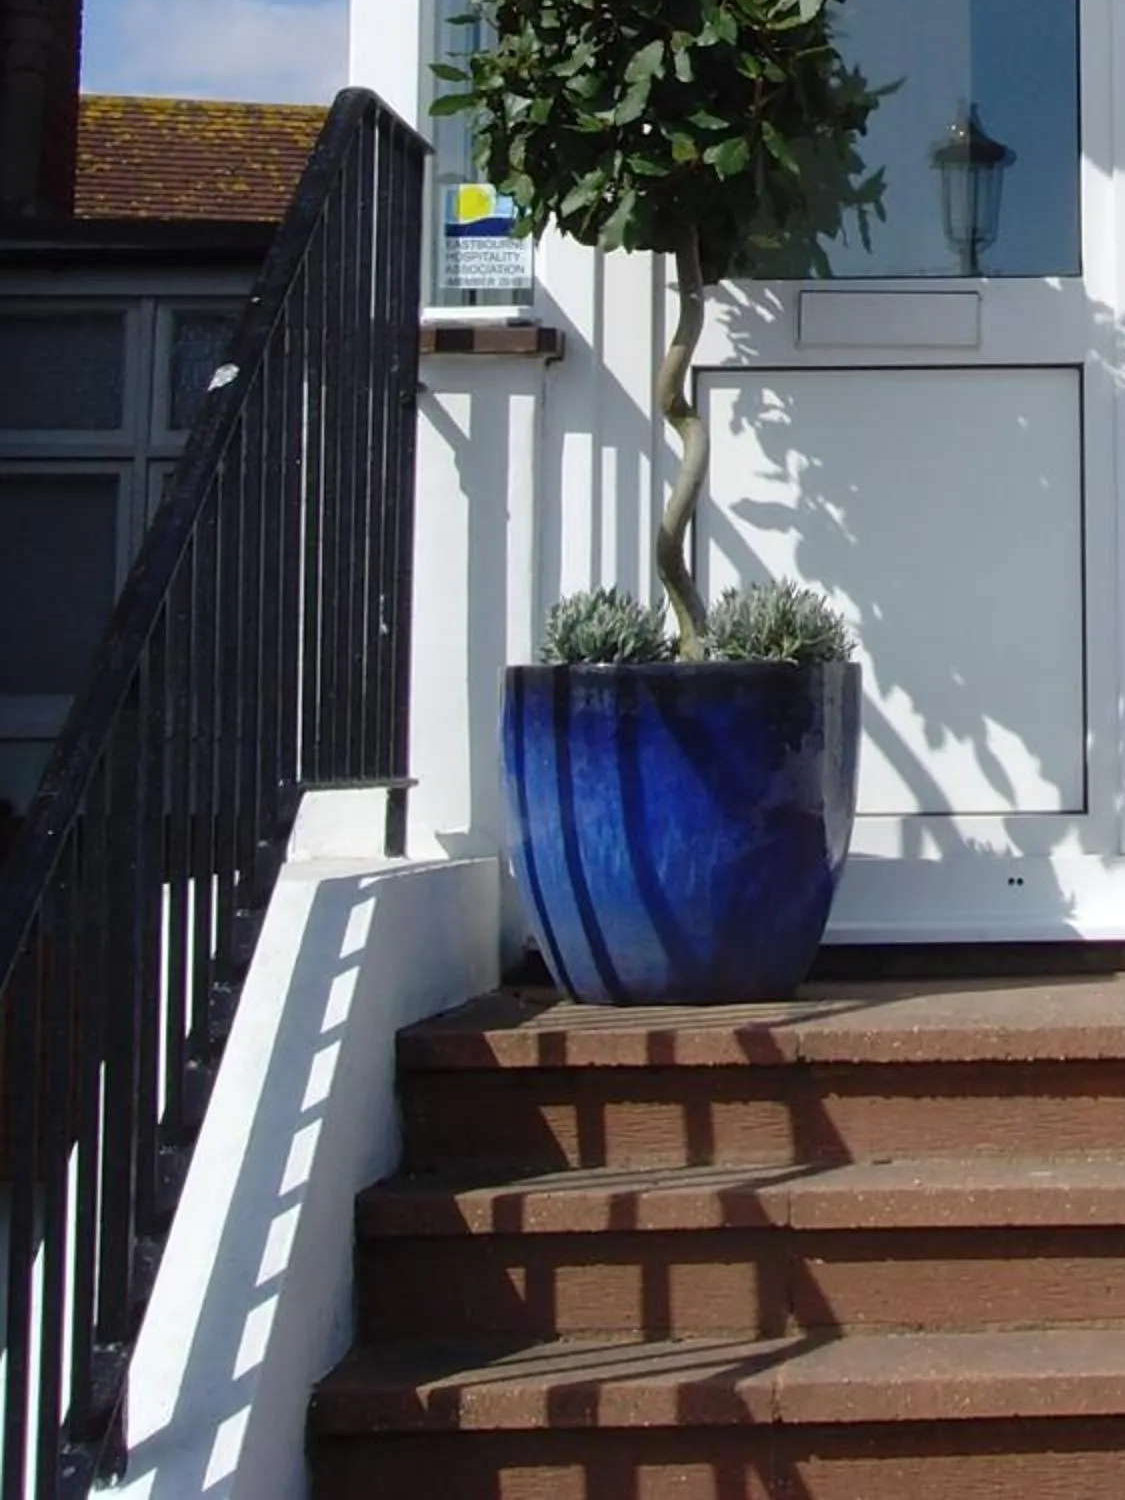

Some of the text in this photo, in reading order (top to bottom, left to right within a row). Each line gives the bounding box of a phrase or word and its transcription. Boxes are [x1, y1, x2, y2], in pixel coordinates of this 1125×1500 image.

[446, 240, 524, 250] EASTBOURNE
[446, 252, 521, 262] HOSPITALITY
[446, 264, 525, 274] ASSOCIATION
